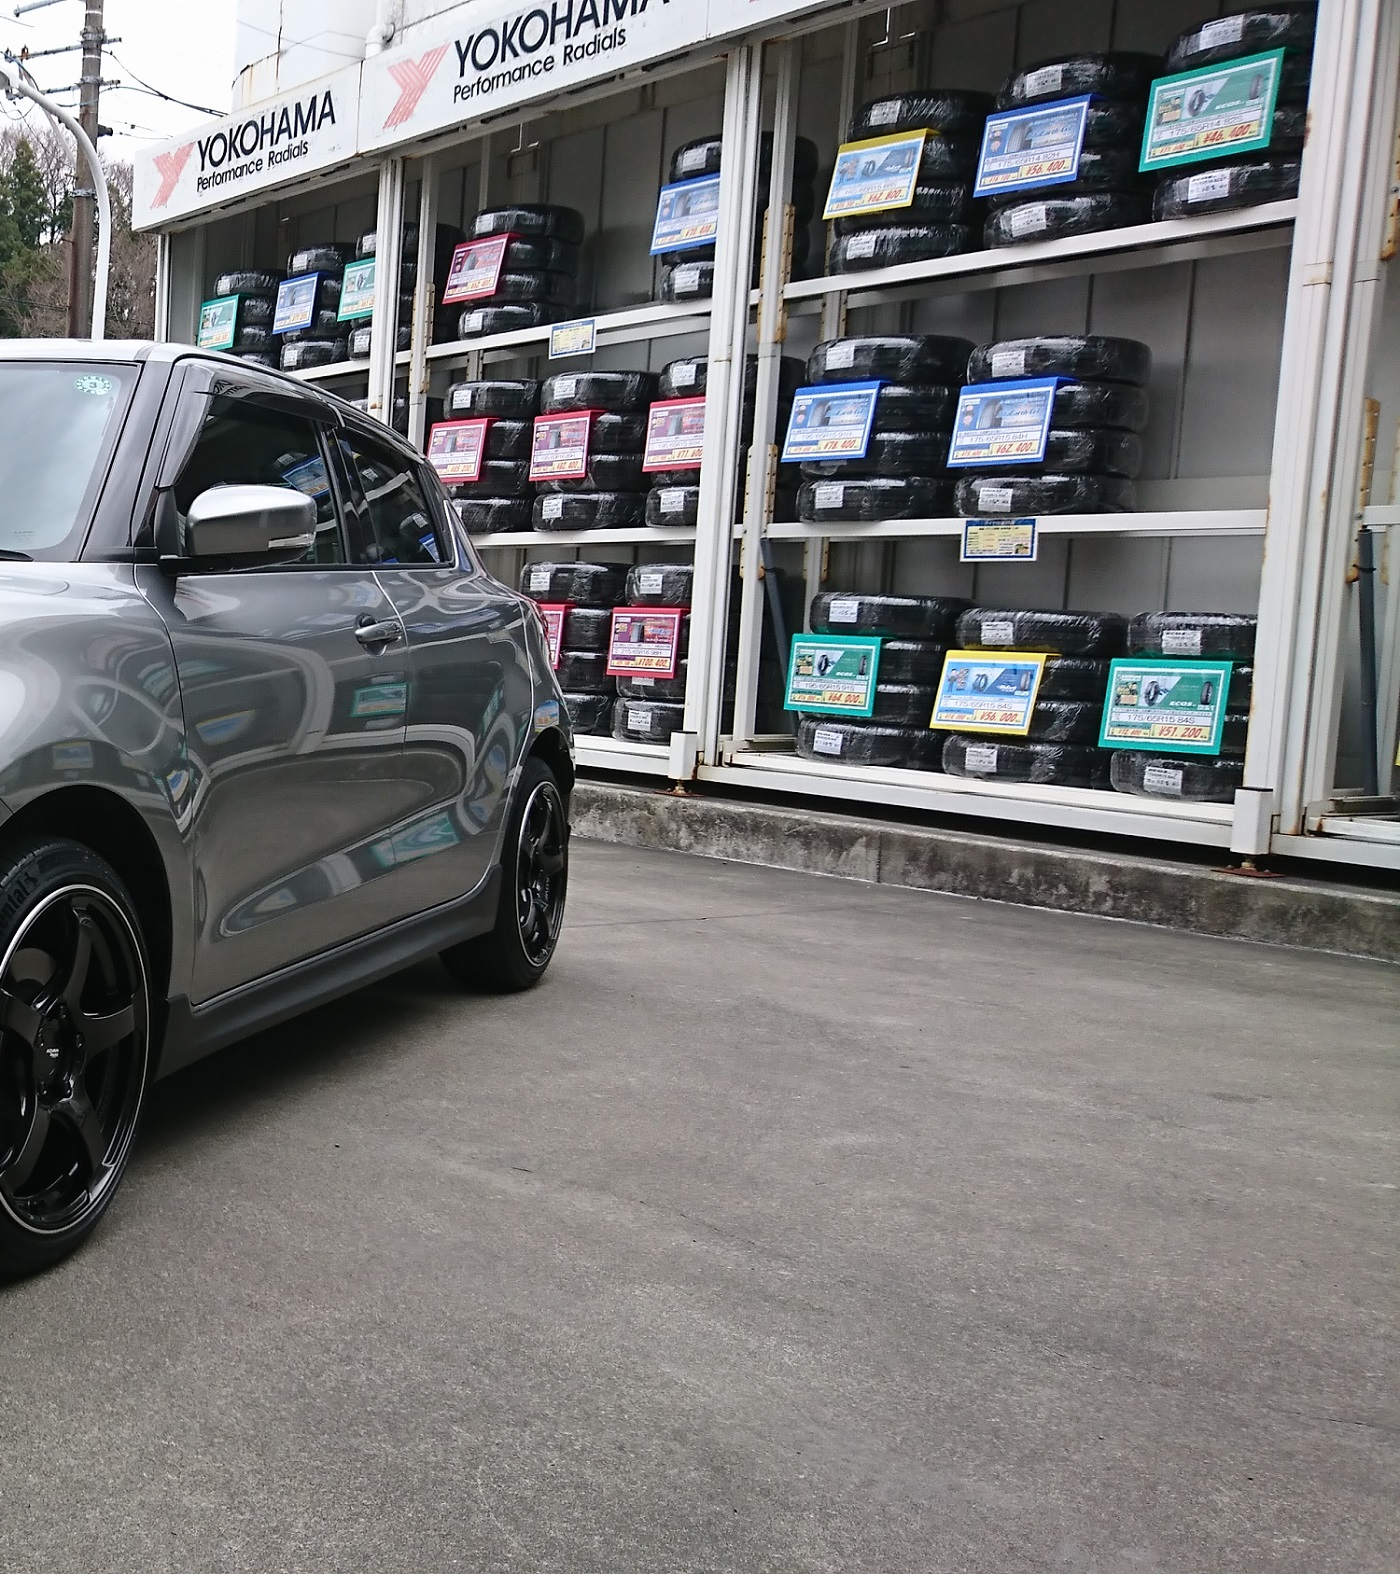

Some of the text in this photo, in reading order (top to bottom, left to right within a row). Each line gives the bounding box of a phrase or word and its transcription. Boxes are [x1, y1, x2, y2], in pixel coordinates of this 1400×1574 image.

[453, 28, 627, 104] Performance Radials
[454, 0, 670, 78] YOKOHAM
[196, 140, 309, 193] Performance Radials
[197, 90, 336, 172] YOKOHAMA
